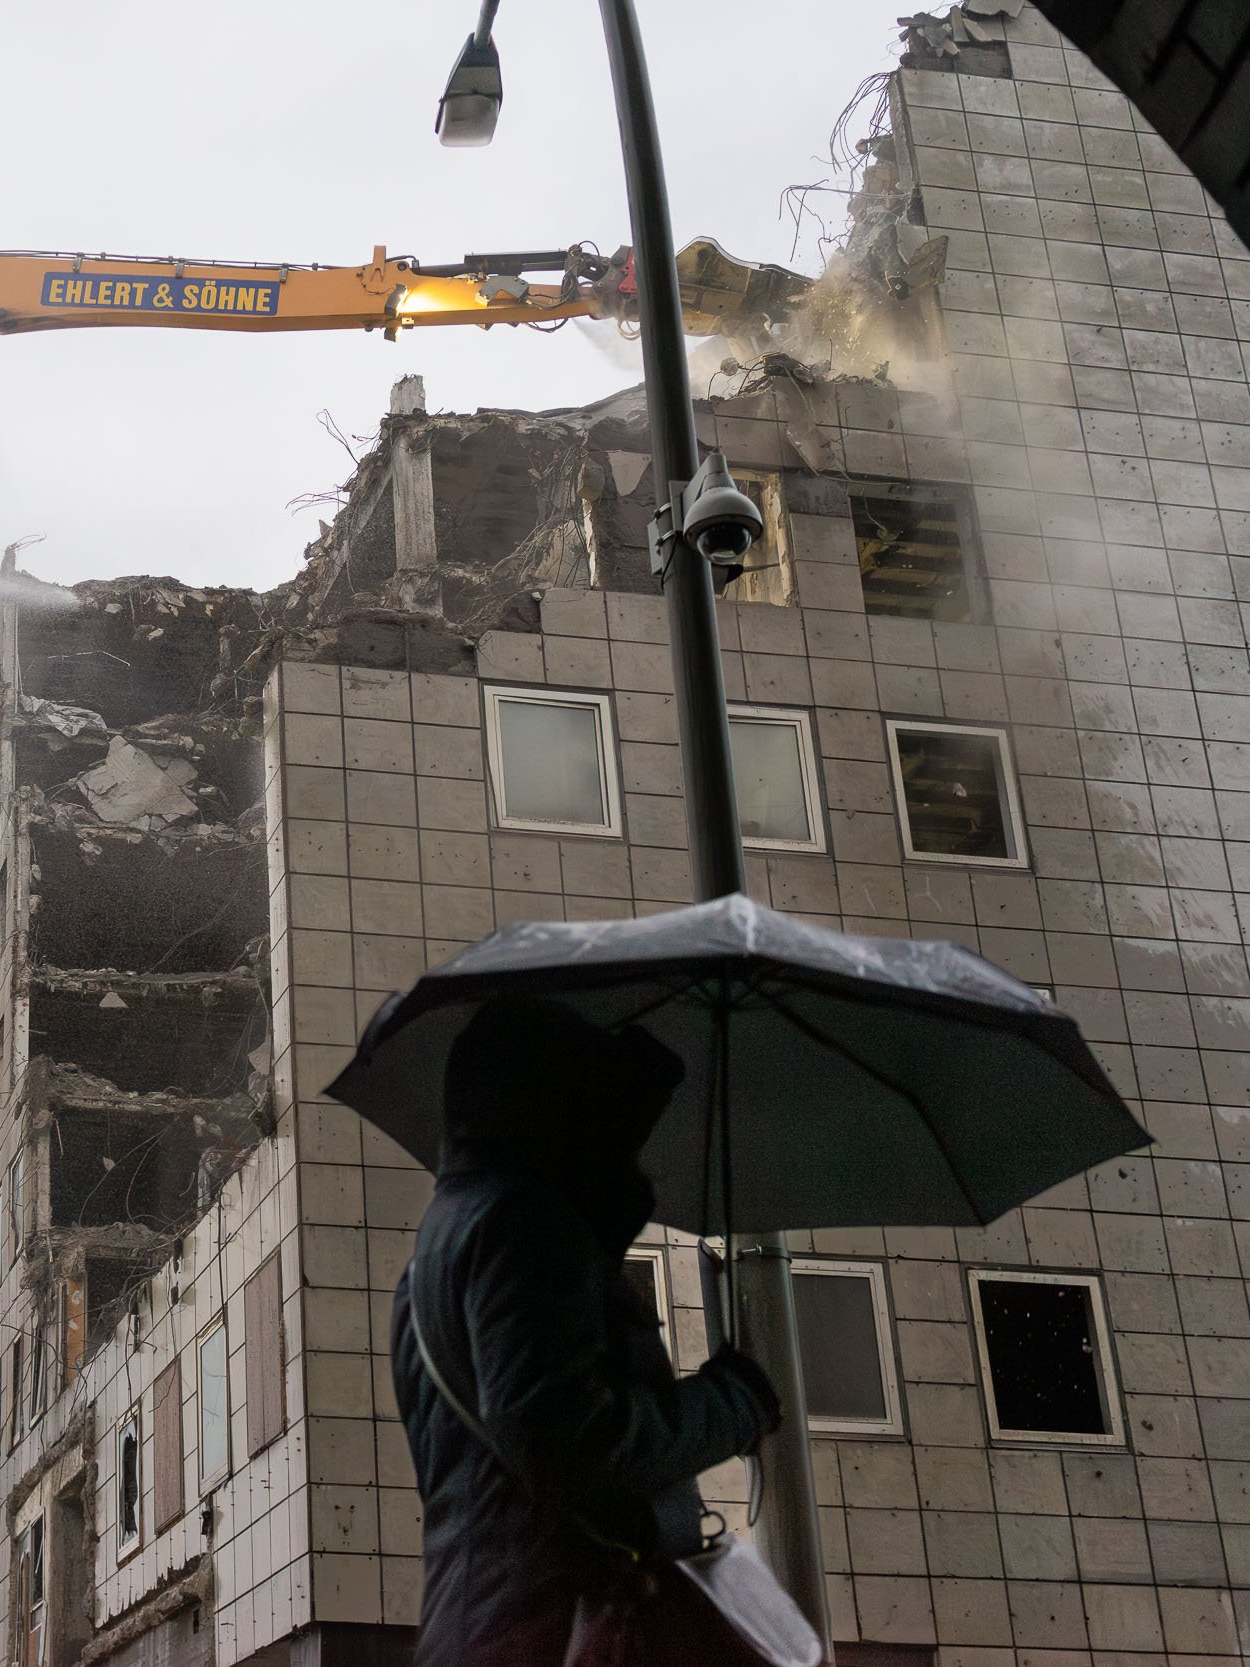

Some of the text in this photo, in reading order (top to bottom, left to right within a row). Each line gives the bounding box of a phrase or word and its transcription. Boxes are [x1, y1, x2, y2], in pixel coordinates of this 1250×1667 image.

[48, 278, 272, 312] EHLERT & SÖHNE
